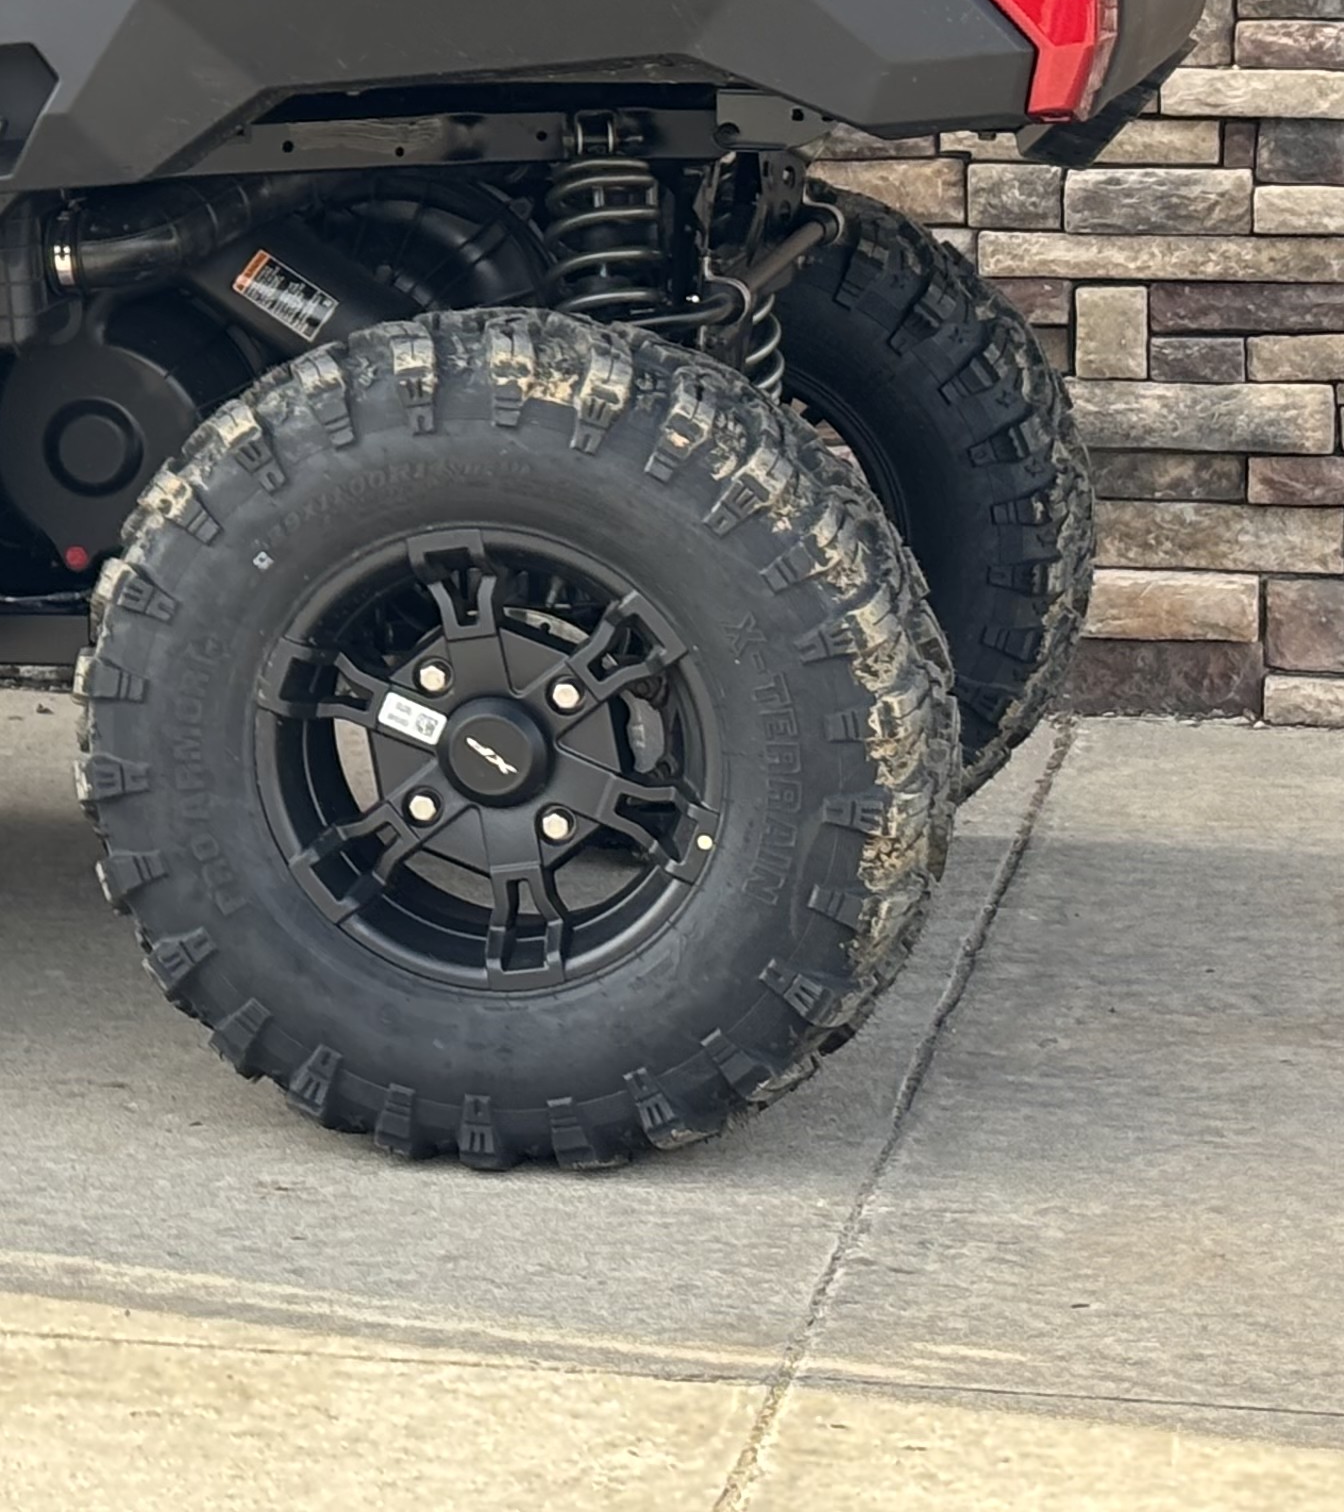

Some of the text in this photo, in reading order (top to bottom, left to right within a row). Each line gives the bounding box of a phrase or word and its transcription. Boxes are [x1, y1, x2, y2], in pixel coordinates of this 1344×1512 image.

[173, 666, 215, 821] ARMOR
[465, 736, 518, 775] XP
[722, 610, 803, 906] X-TERRAIN
